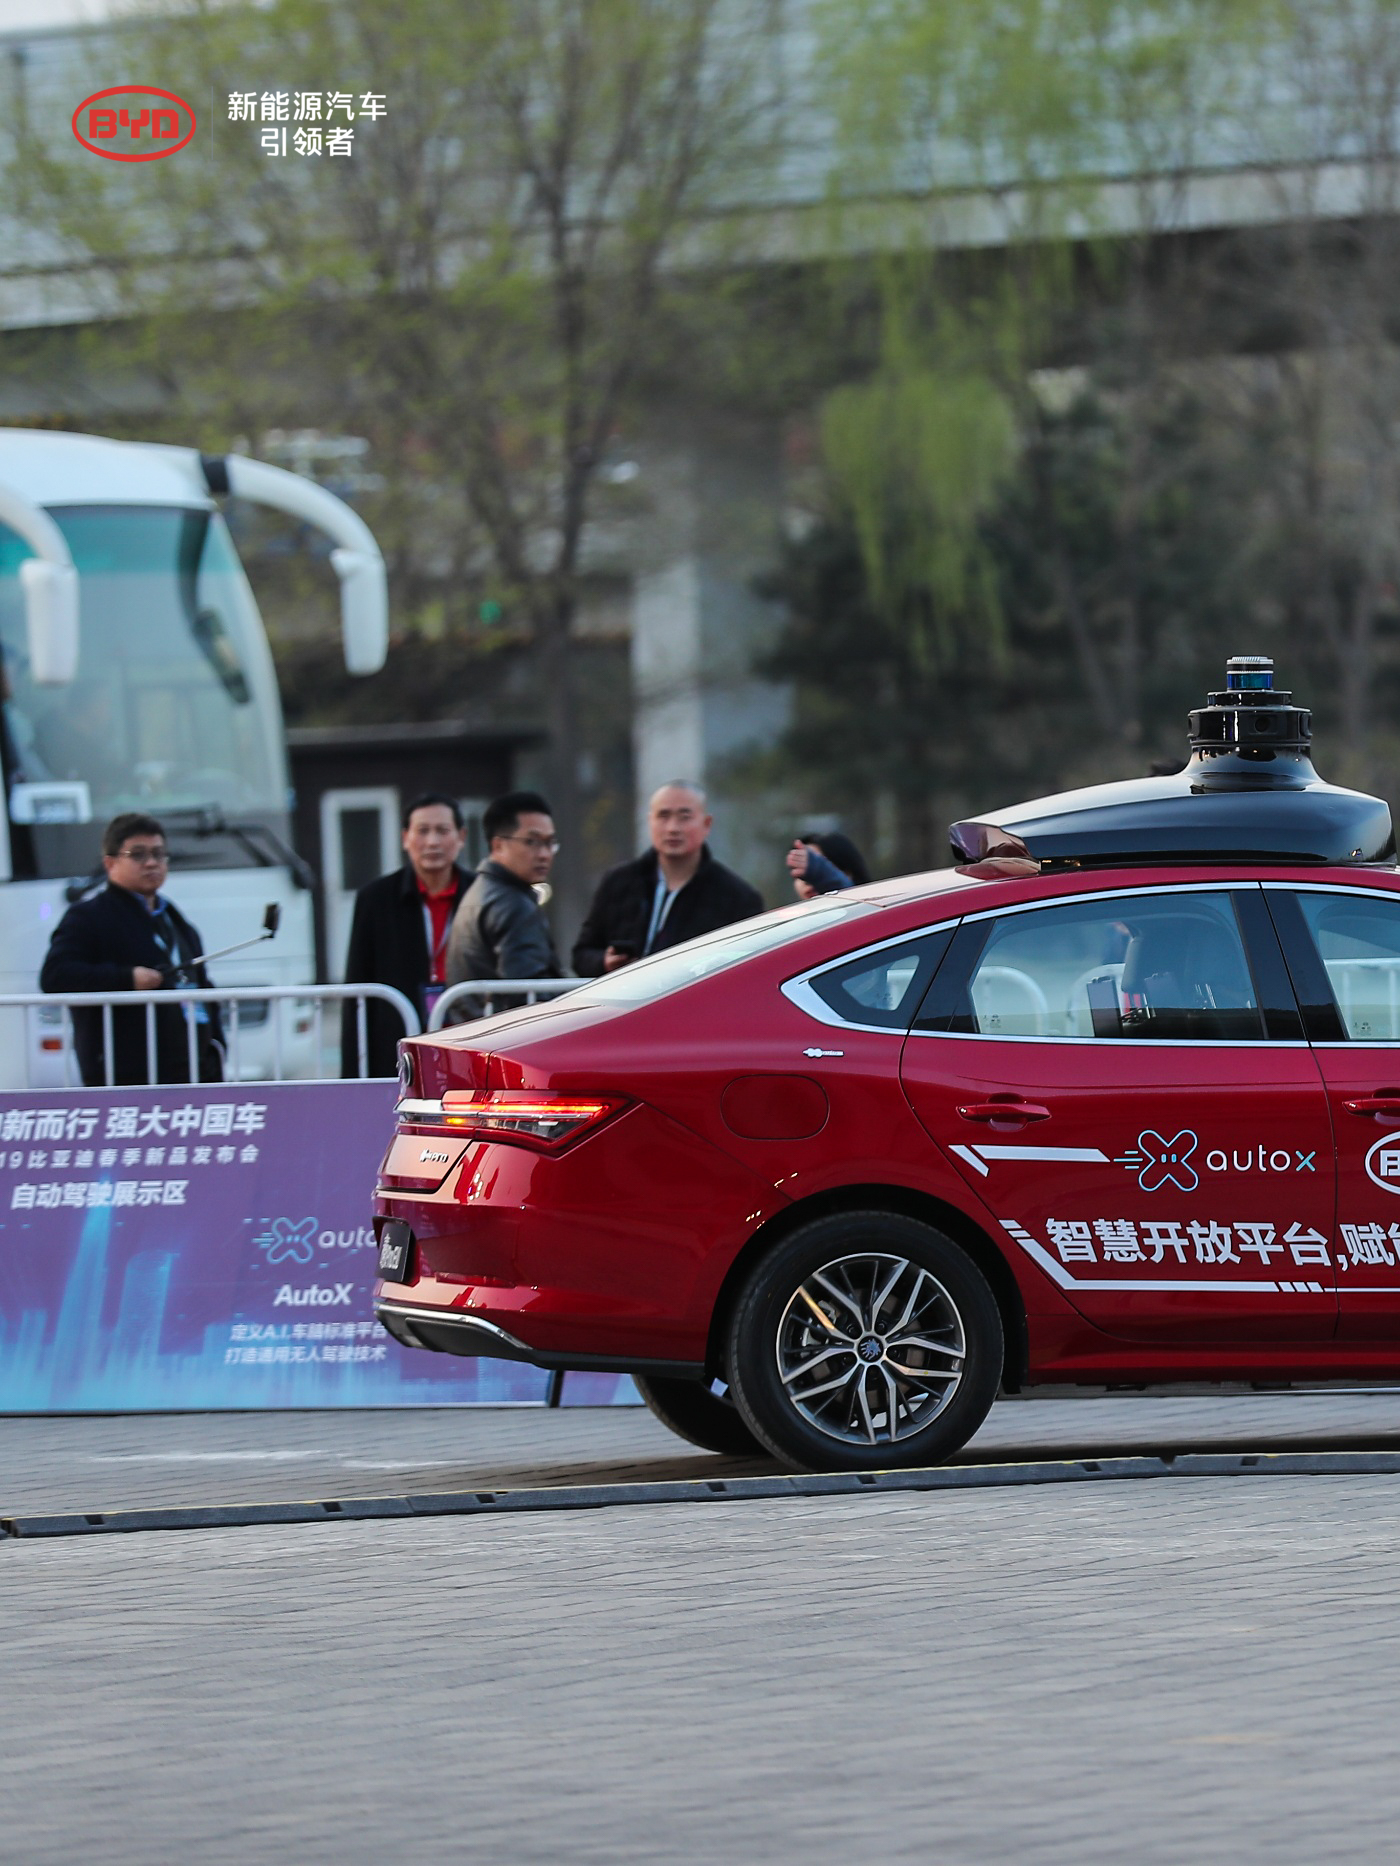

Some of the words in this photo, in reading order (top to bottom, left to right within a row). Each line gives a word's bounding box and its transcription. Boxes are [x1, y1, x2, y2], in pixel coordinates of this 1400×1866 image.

[0, 1107, 99, 1142] 新而行
[104, 1102, 268, 1140] 强大中国车
[1206, 1148, 1316, 1172] autox
[10, 1179, 189, 1210] 自动驾驶展示区
[273, 1283, 354, 1307] AutoX
